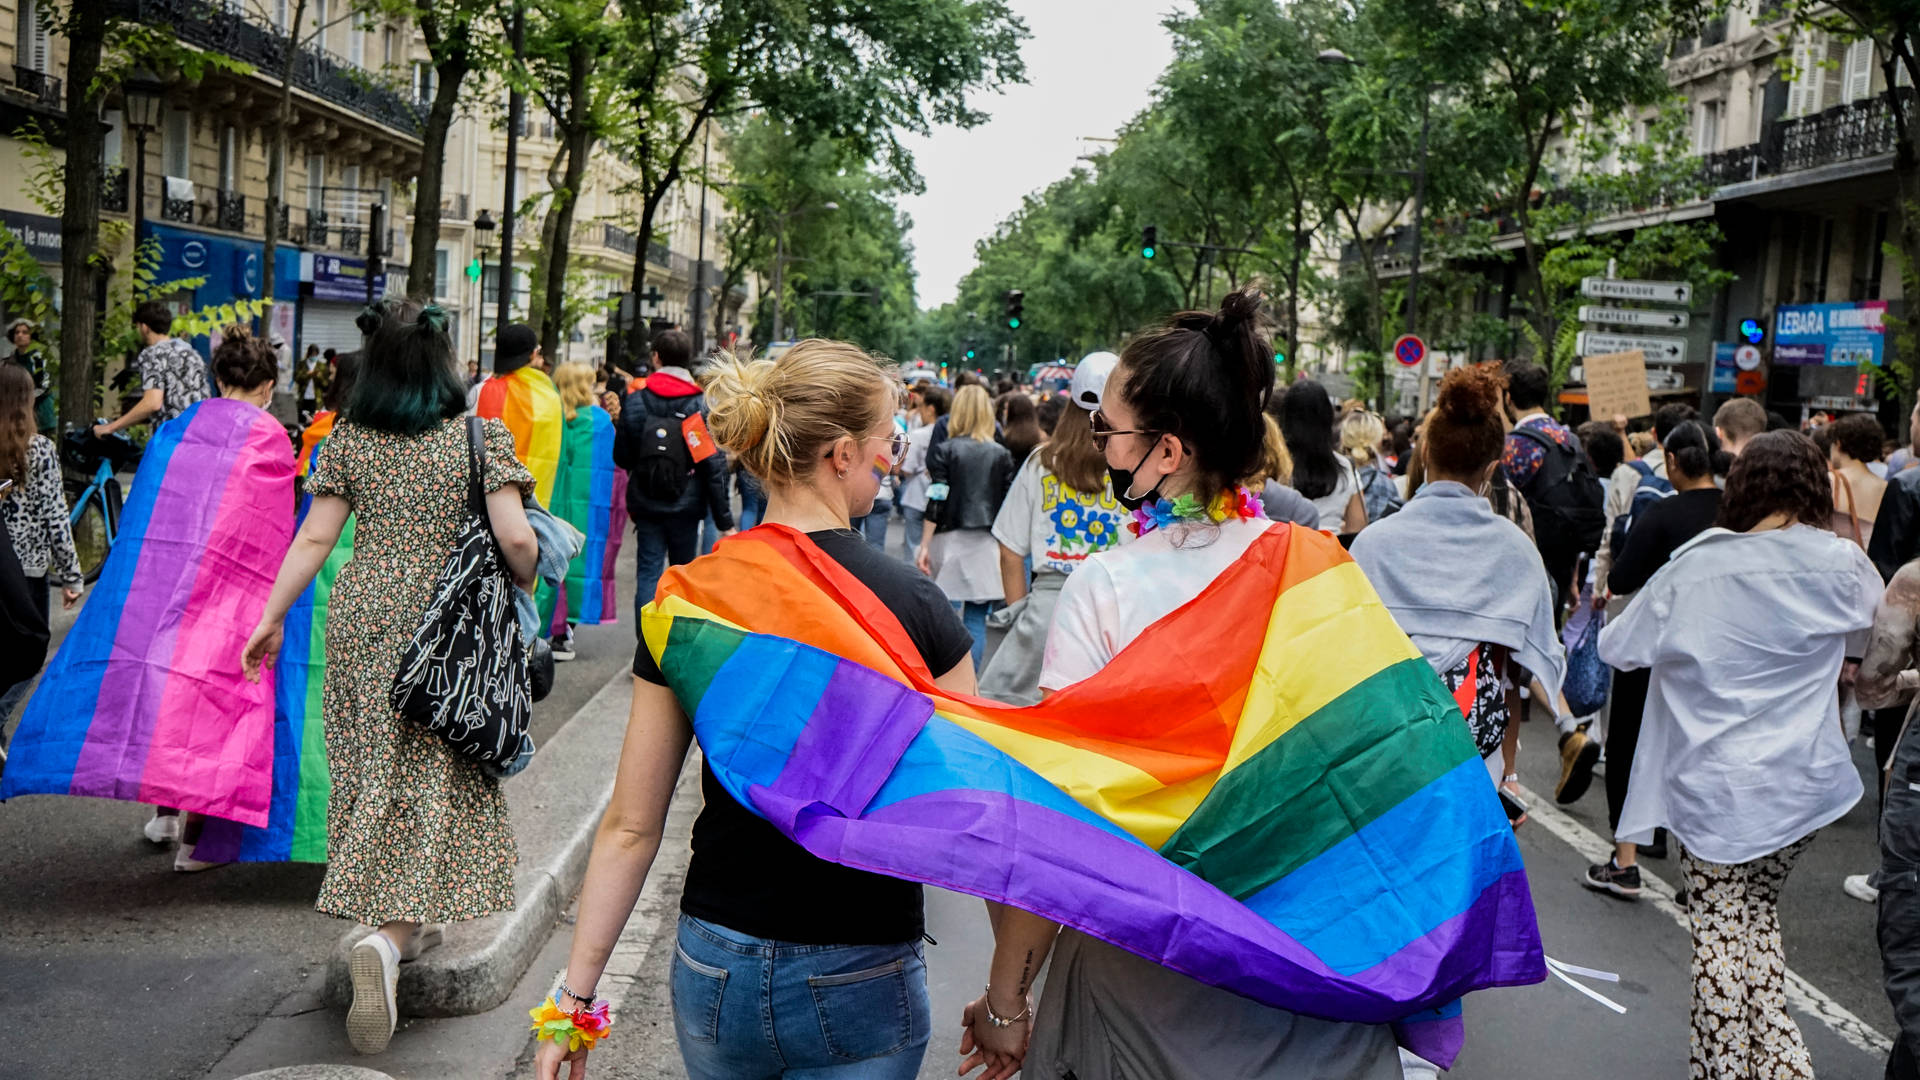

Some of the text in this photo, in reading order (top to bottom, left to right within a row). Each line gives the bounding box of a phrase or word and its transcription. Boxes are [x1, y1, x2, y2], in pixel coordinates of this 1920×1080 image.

[24, 225, 36, 246] le
[1592, 283, 1655, 297] RÉPUBLIQUE
[1777, 310, 1825, 335] LEBARA
